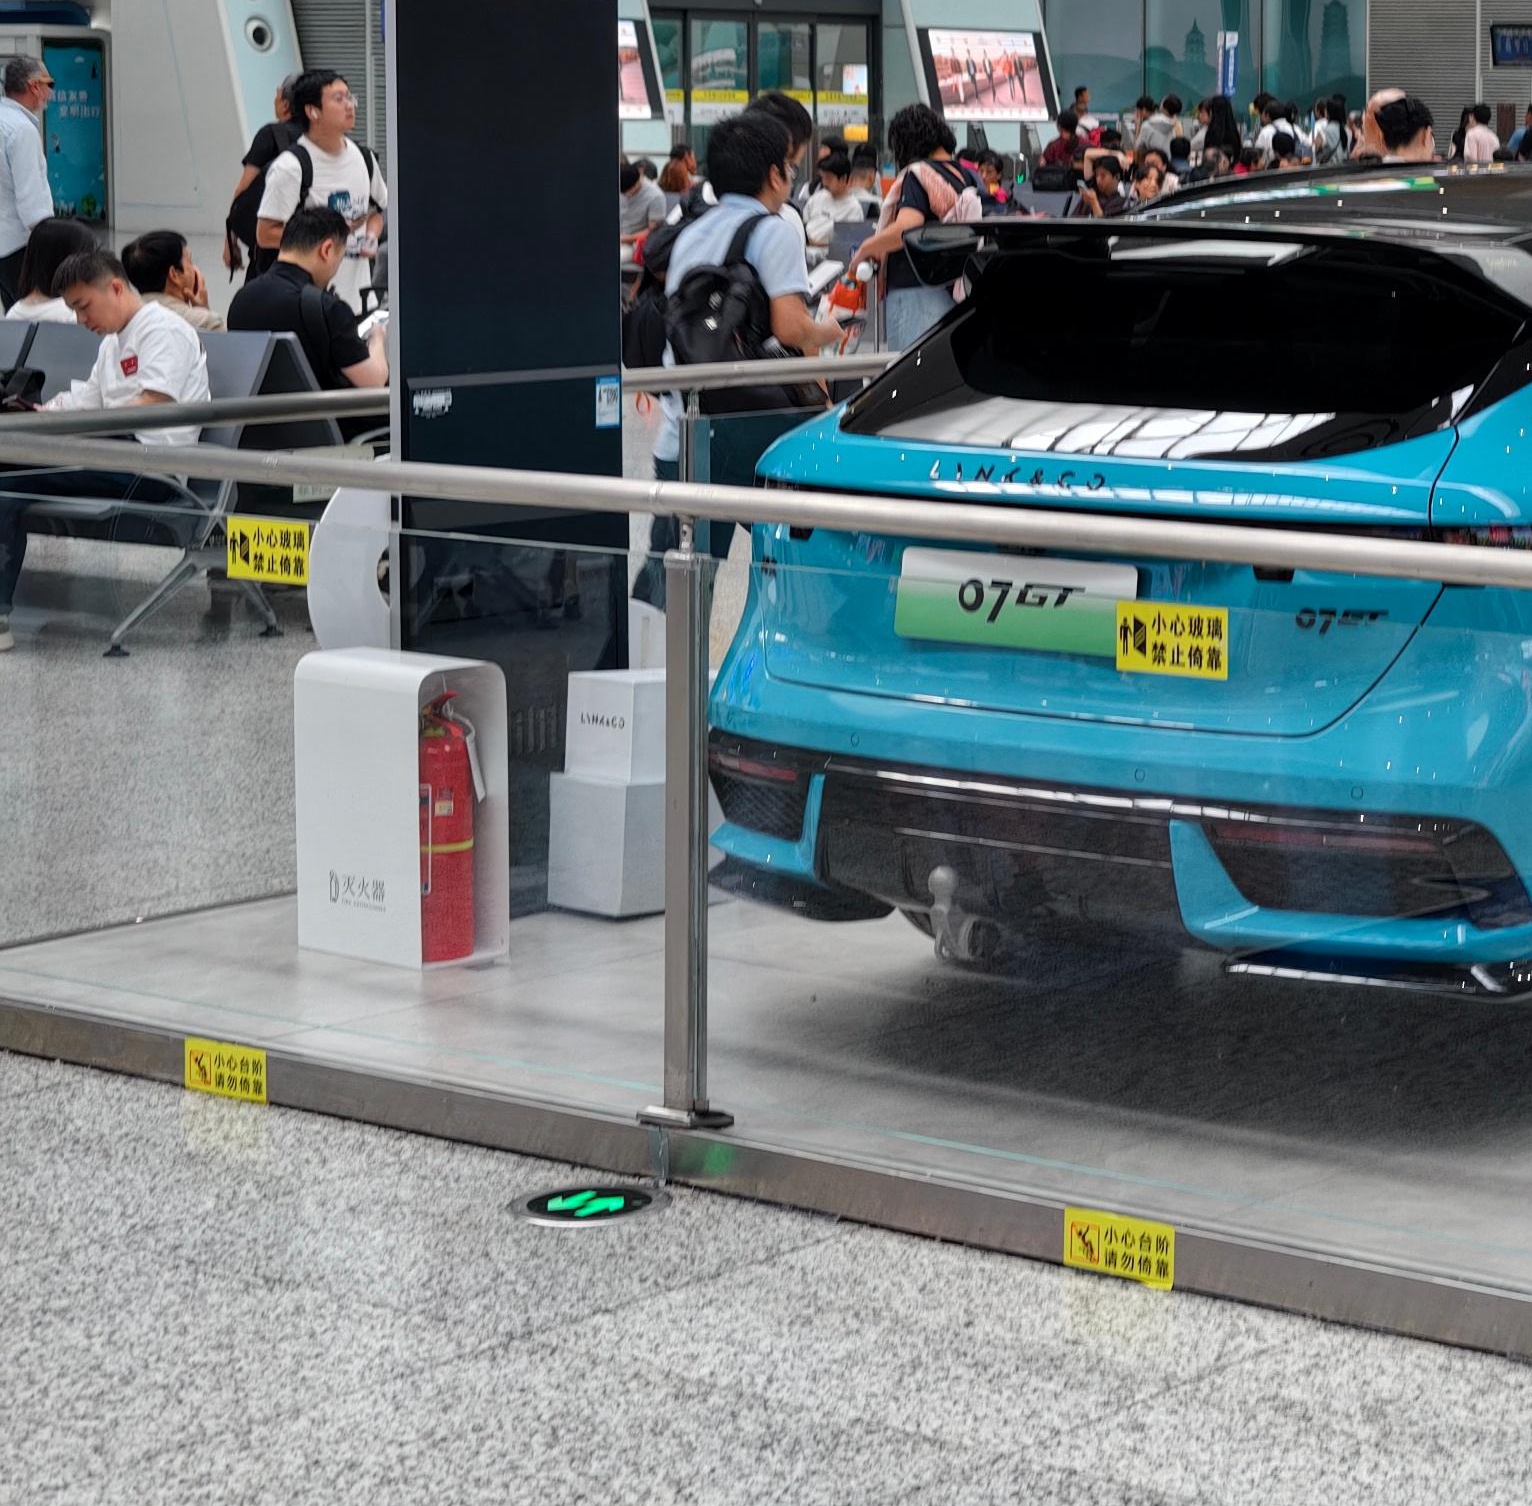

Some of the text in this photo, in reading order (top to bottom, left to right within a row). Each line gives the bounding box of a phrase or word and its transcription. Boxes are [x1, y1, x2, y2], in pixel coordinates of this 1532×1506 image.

[253, 525, 304, 552] 小心玻璃
[253, 551, 304, 578] 禁止倚靠
[957, 578, 1086, 624] 07GT
[1151, 610, 1224, 643] 小心玻璃
[1150, 643, 1223, 674] 禁止倚靠
[342, 875, 385, 903] 灭火器
[213, 1052, 263, 1077] 小心台阶
[215, 1072, 263, 1097] 请勿倚靠
[1104, 1225, 1170, 1256] 小心台阶
[1104, 1249, 1170, 1280] 请勿倚靠
